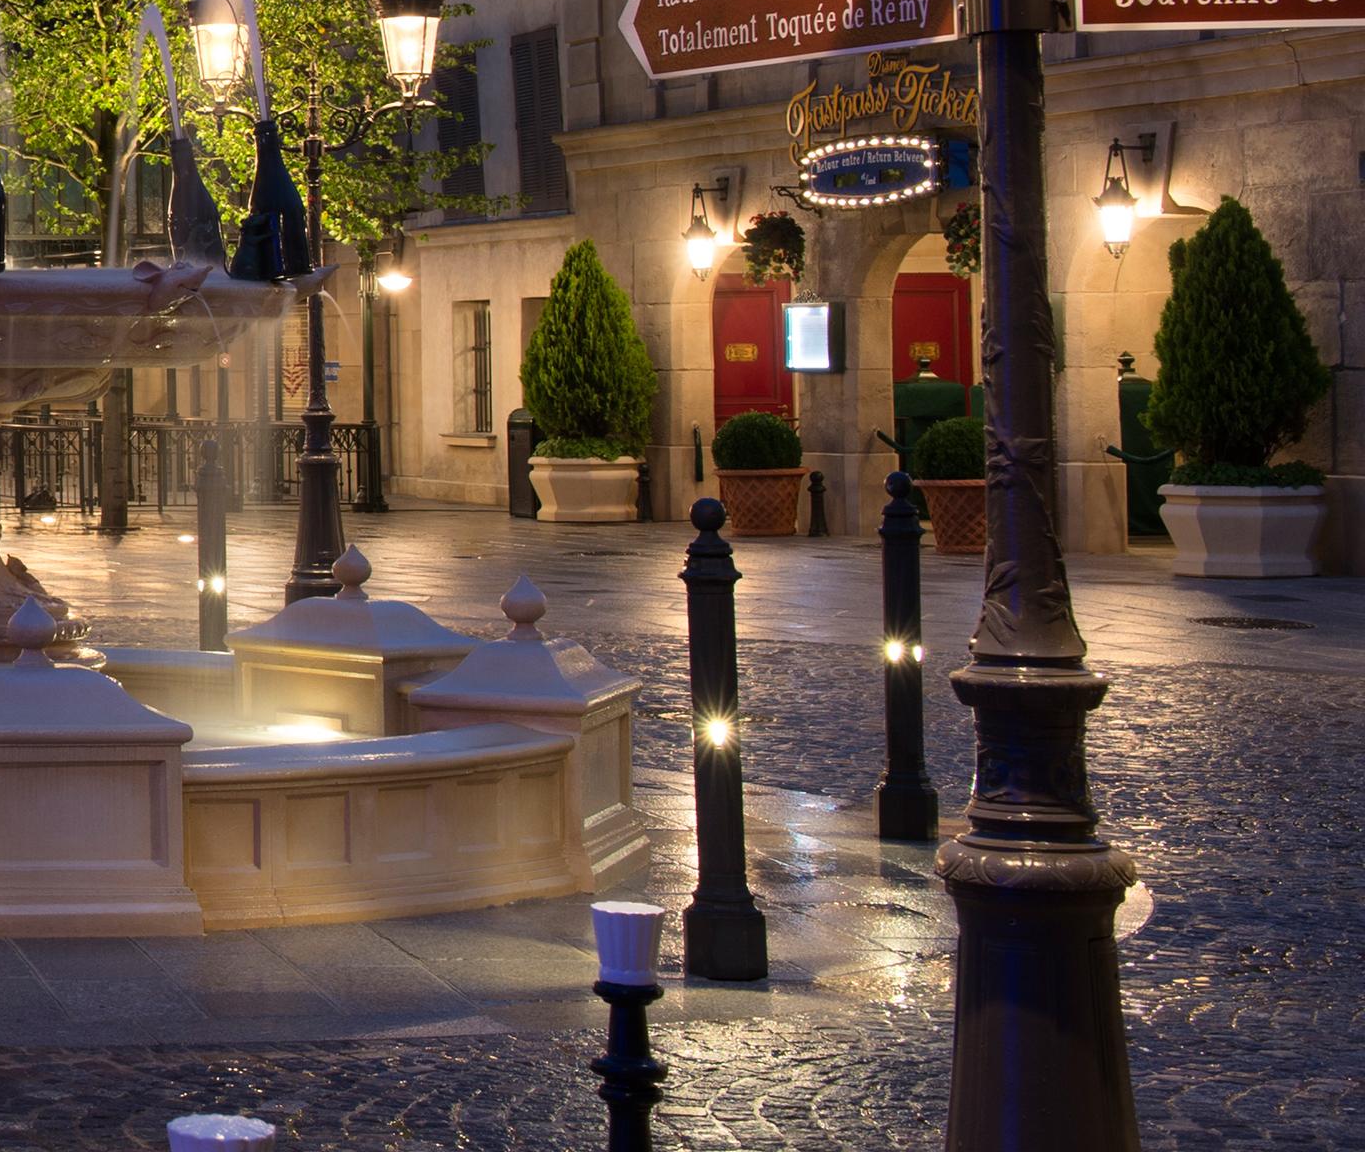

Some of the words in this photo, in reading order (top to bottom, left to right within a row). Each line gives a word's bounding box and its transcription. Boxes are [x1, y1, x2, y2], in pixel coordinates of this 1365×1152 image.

[658, 12, 758, 56] Totalement
[765, 1, 836, 47] Toquée
[786, 80, 890, 162] Fastpass
[816, 159, 839, 173] Retour
[841, 155, 861, 166] entre
[867, 151, 893, 164] Return
[894, 150, 925, 163] Between
